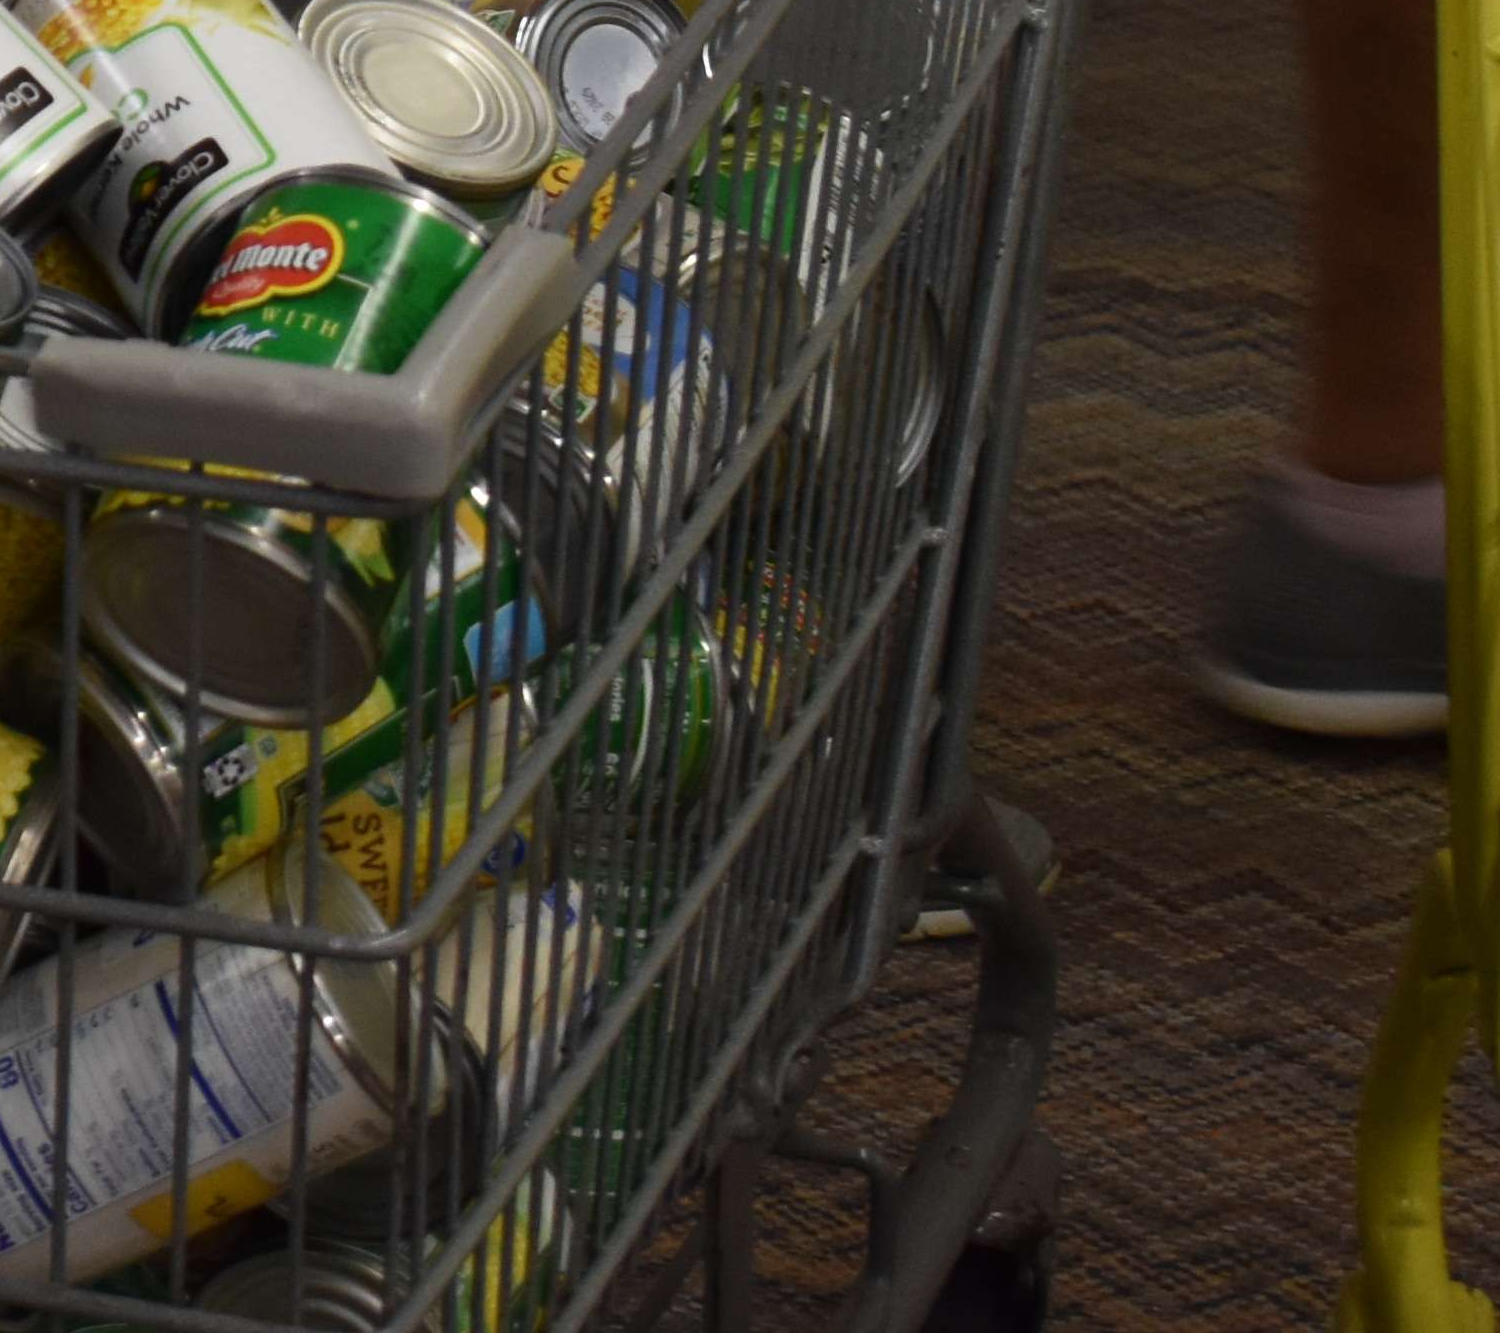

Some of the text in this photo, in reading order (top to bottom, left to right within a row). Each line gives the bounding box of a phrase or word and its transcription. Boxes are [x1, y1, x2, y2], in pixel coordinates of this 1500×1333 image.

[119, 93, 192, 154] Whole
[149, 148, 218, 213] Clover
[236, 238, 330, 274] Monte
[260, 304, 341, 341] WITH
